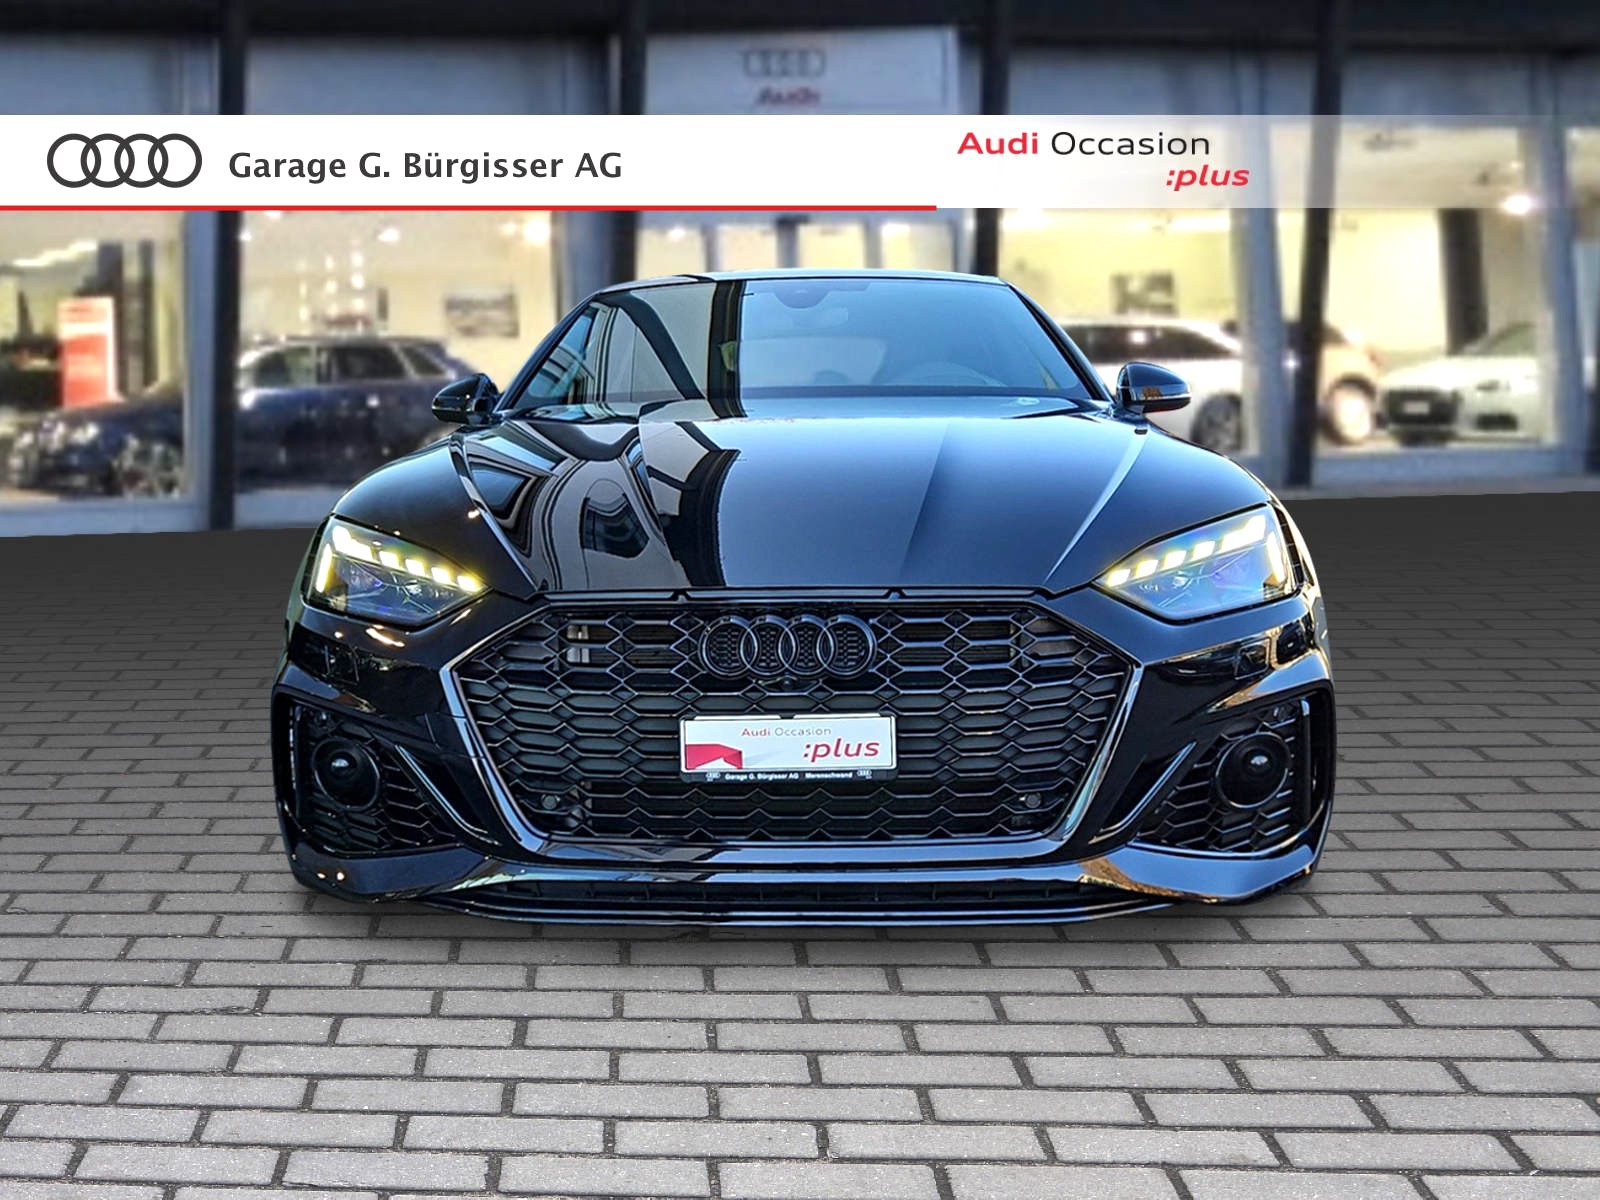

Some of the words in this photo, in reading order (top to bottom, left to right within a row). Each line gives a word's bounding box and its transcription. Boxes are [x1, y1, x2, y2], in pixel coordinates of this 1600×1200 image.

[741, 727, 771, 737] Audi
[774, 727, 832, 737] Occasion
[803, 738, 880, 763] :plus
[724, 772, 748, 781] Garage
